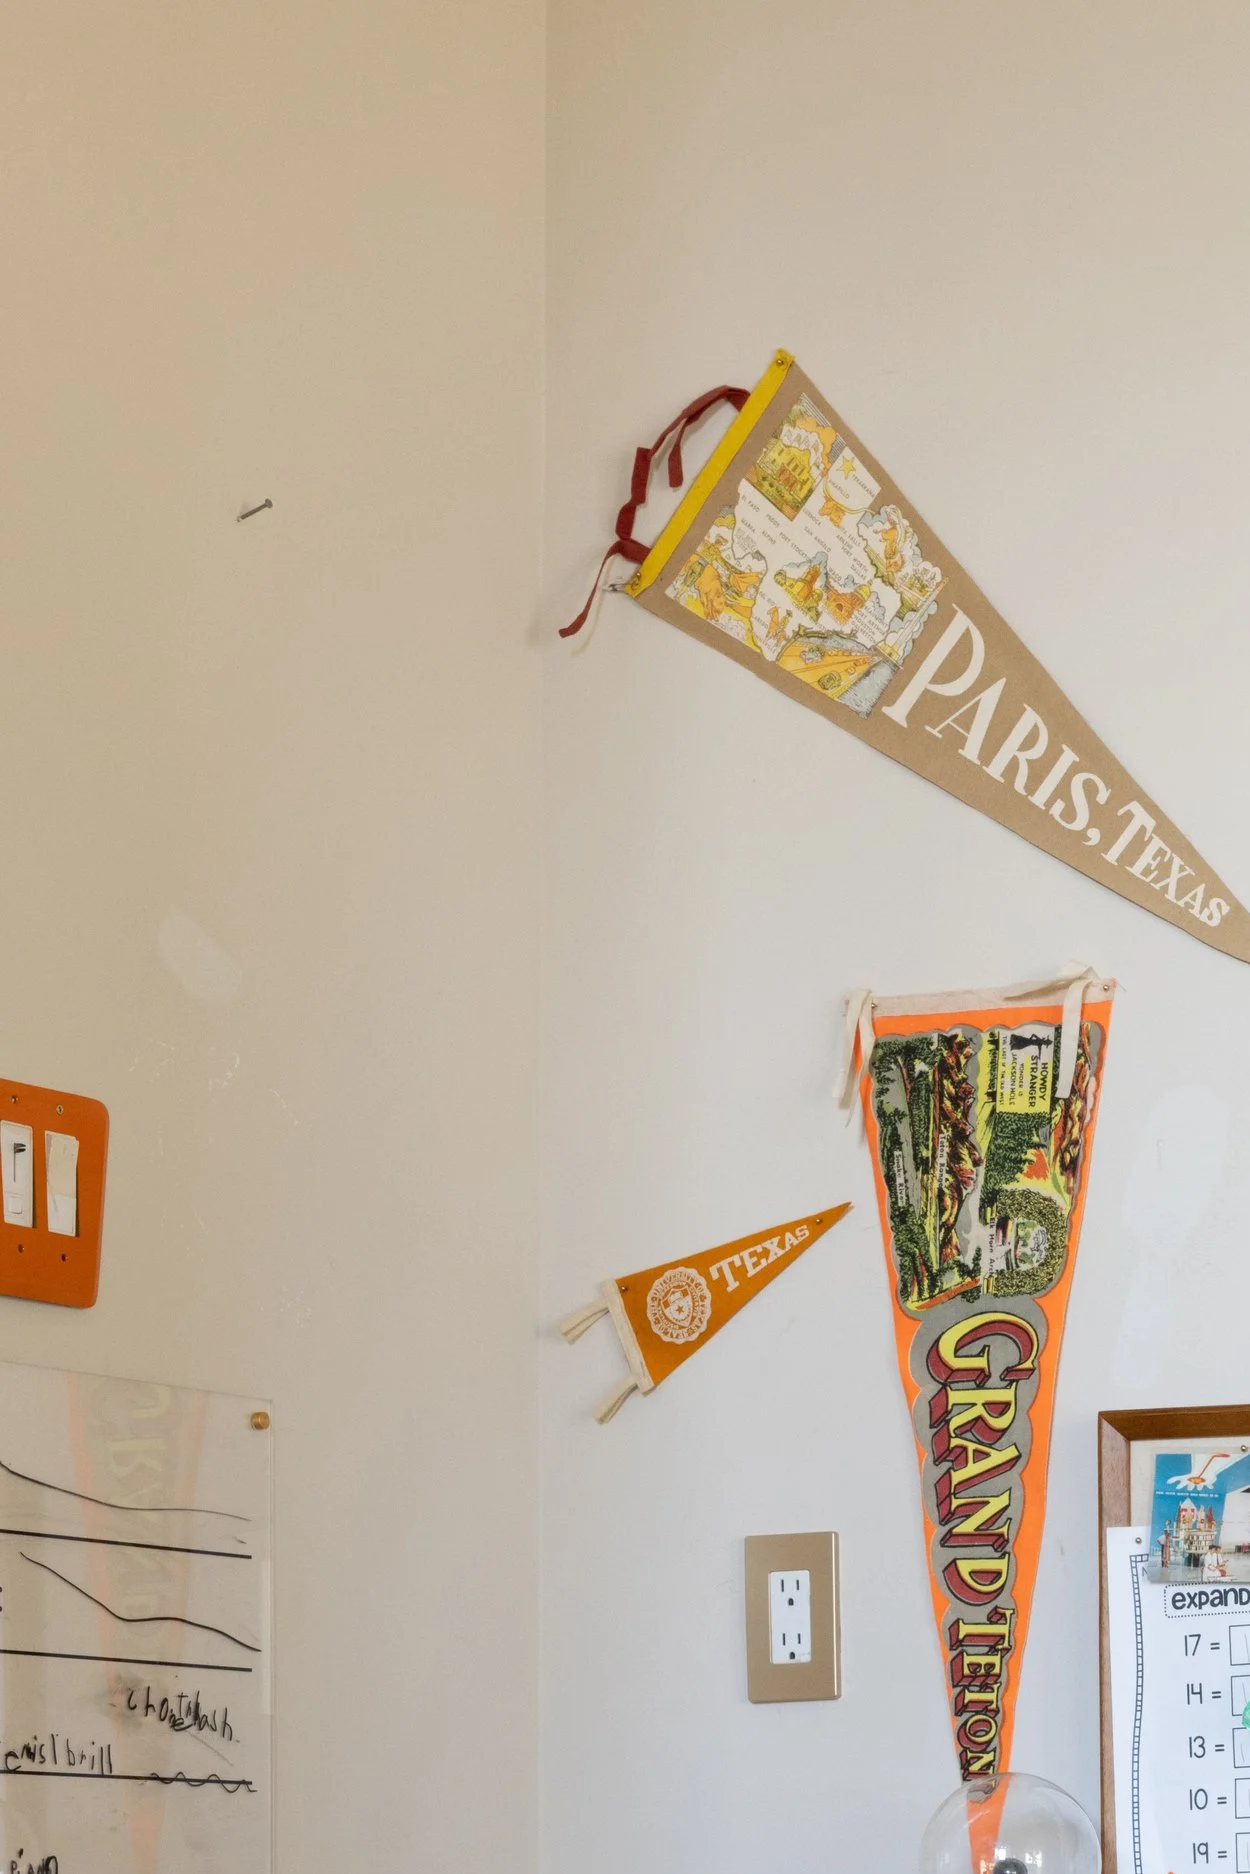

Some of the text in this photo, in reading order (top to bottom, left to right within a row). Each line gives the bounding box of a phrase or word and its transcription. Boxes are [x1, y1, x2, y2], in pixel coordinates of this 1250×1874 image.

[882, 603, 1229, 927] PARIS, TEXAS
[1027, 1055, 1038, 1109] STRANGER
[1039, 1062, 1048, 1101] HOWDY
[708, 1225, 809, 1293] TEXAS
[926, 1312, 1036, 1792] GRAND TETON
[1184, 1633, 1202, 1657] 17
[1186, 1682, 1203, 1705] 14
[1189, 1735, 1206, 1759] 13
[1189, 1787, 1209, 1811] 10
[1192, 1842, 1209, 1864] 19
